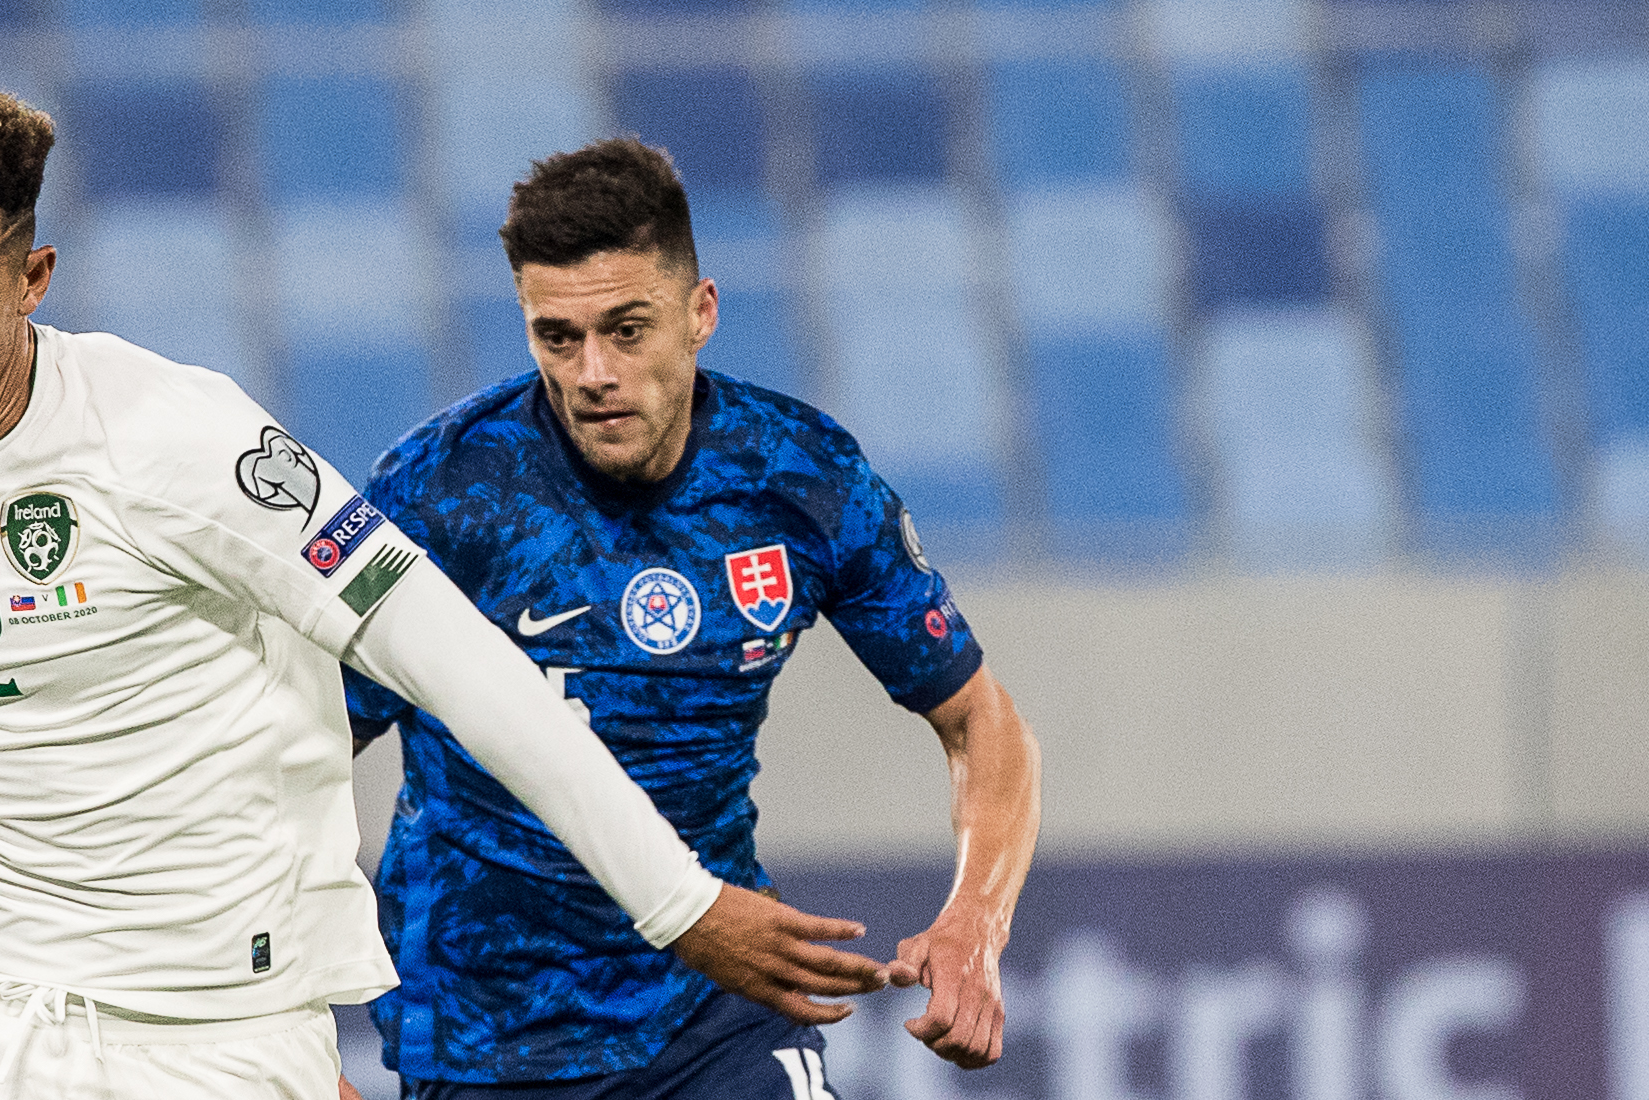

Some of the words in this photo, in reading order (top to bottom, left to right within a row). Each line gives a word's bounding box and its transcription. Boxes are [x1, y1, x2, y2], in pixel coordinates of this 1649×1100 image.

[14, 502, 61, 520] Ireland
[21, 611, 72, 624] OCTOBER
[74, 606, 98, 618] 2020
